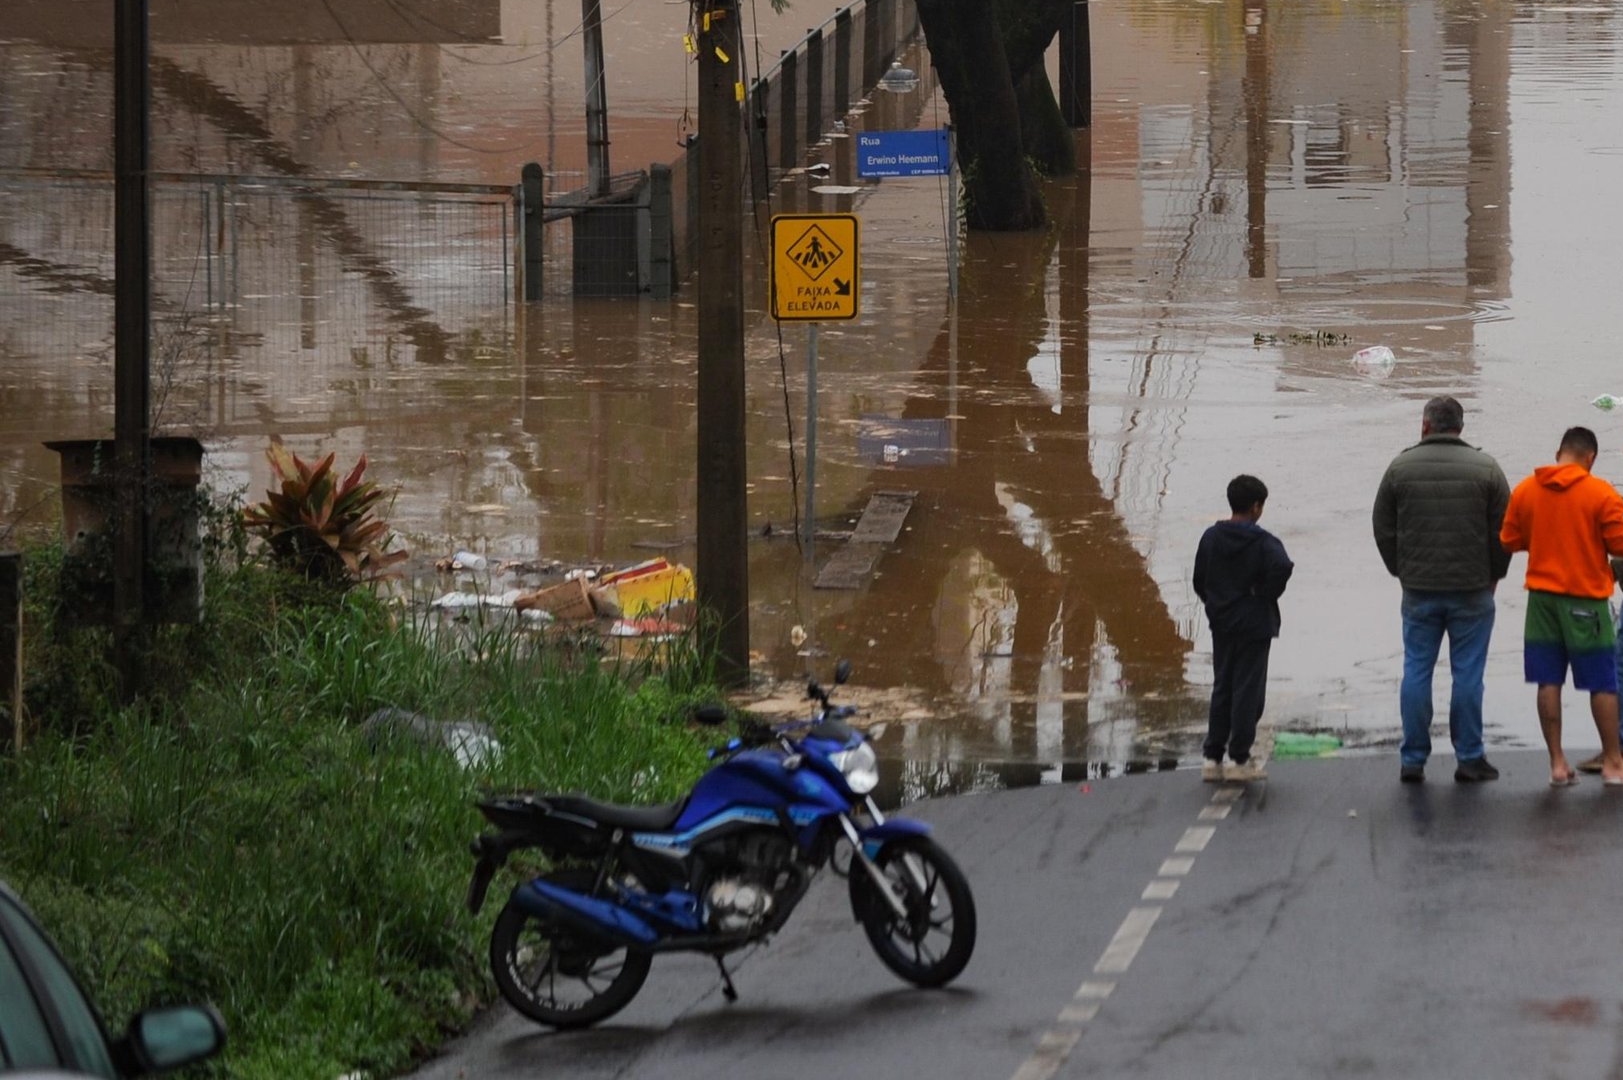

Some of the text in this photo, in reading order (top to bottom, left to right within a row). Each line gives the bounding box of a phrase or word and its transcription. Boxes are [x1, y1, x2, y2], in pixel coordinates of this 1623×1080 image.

[861, 136, 881, 146] Rua
[867, 154, 939, 166] Erwino Heemann
[797, 287, 831, 297] FAIXA
[787, 301, 841, 312] ELEVADA
